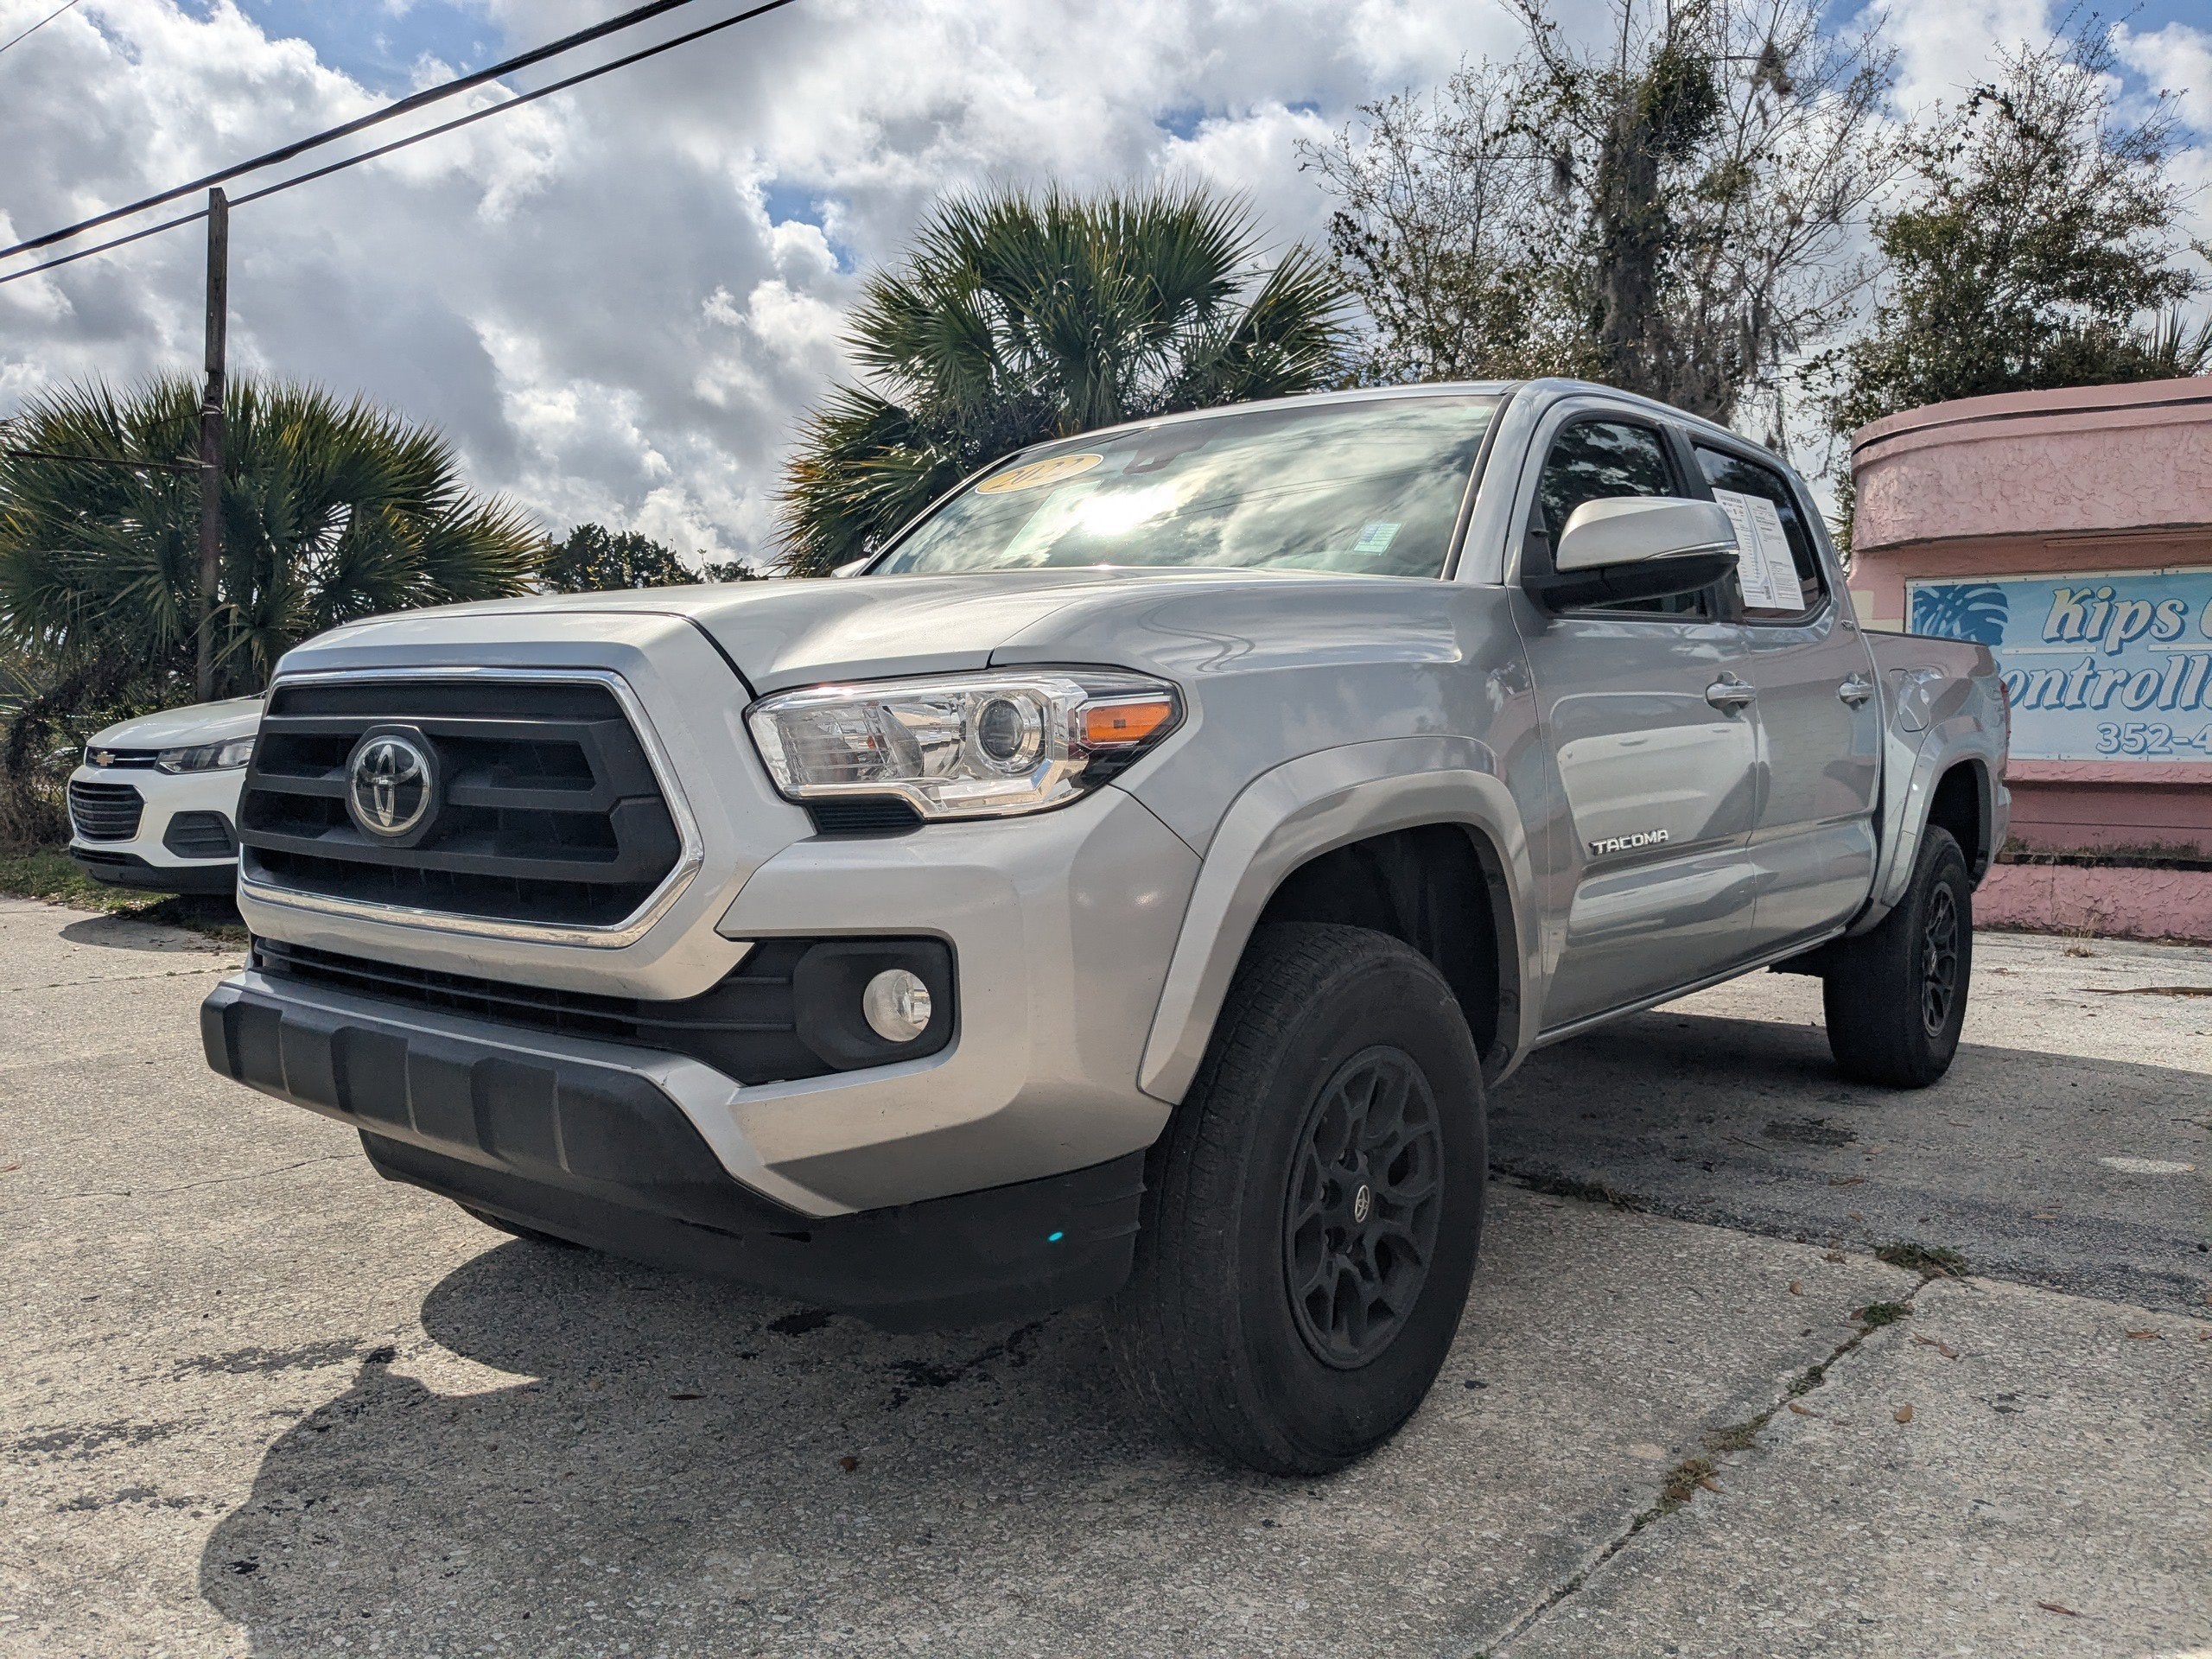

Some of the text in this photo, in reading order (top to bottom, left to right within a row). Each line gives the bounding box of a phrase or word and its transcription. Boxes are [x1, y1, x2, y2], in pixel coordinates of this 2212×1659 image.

[2042, 585, 2189, 657] Kips
[1996, 653, 2212, 712] ontroll
[1589, 828, 1669, 855] TACOMA
